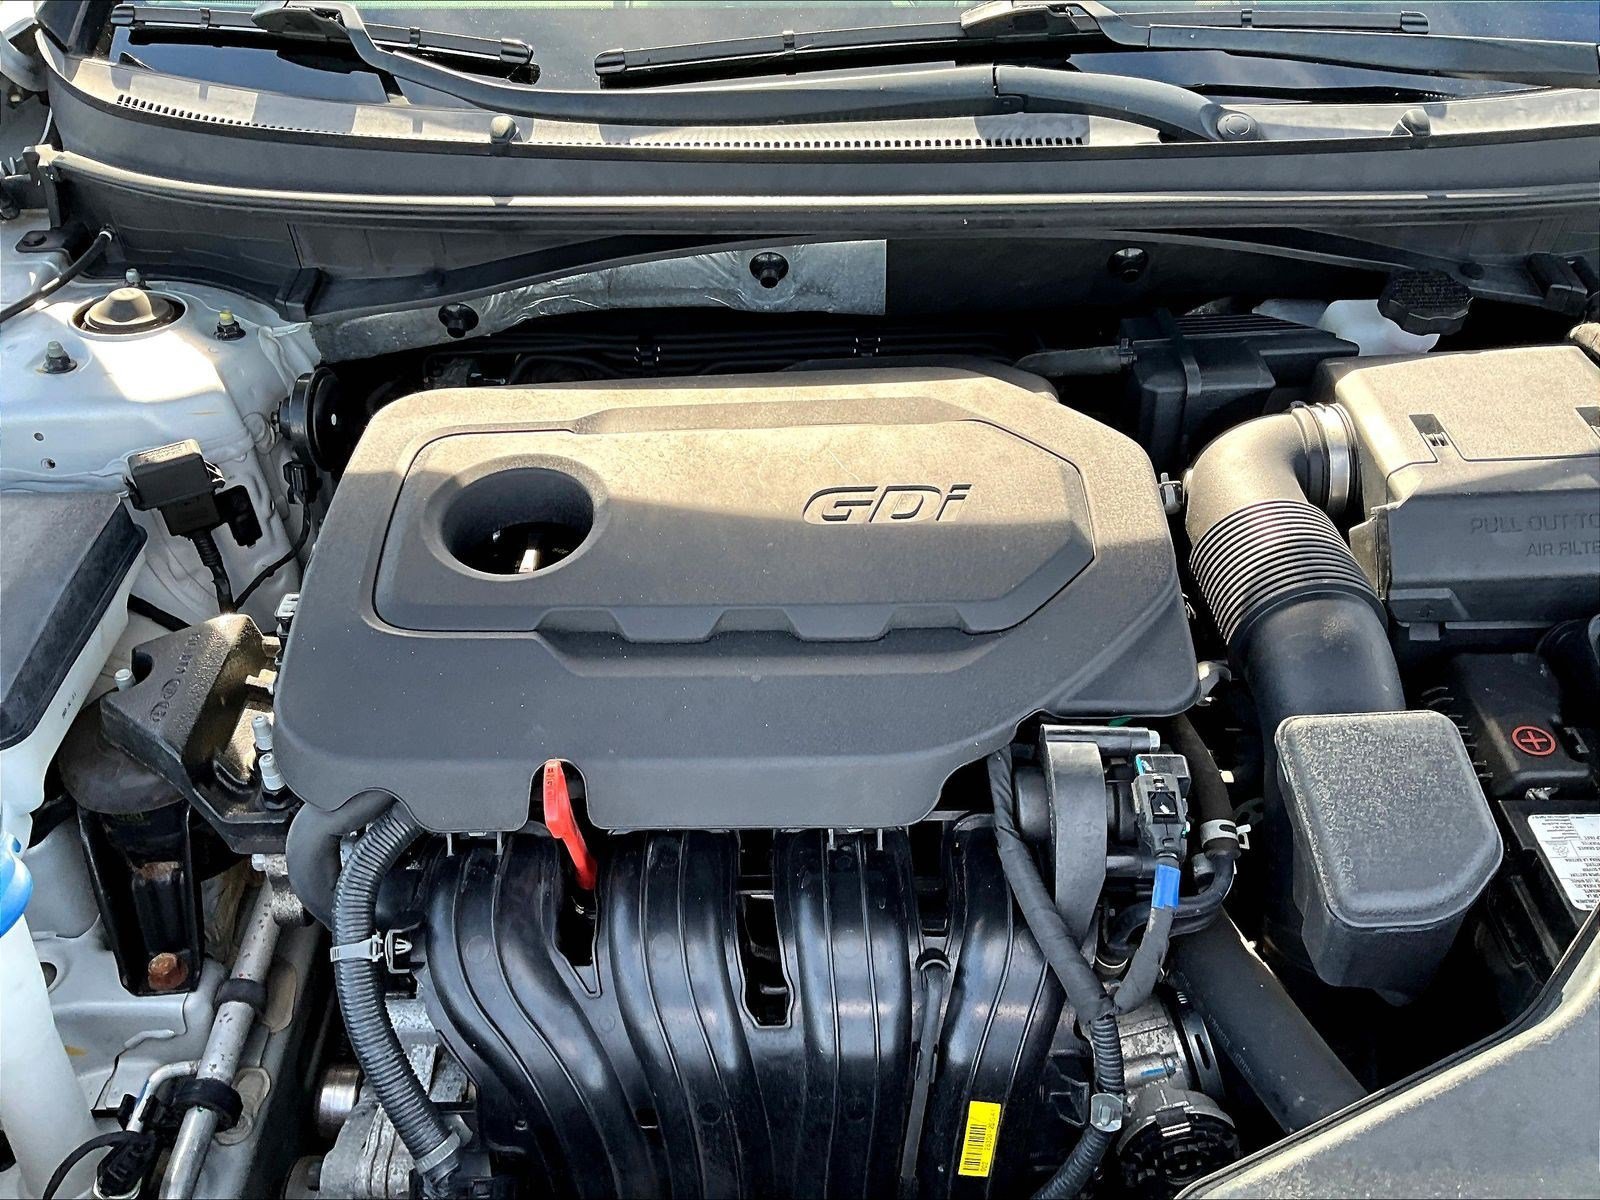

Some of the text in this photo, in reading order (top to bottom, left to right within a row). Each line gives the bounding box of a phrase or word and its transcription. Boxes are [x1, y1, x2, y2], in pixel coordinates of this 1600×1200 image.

[802, 484, 972, 525] GDi
[1470, 516, 1523, 534] PULL
[1528, 513, 1569, 531] OUT
[1526, 542, 1554, 557] AIR
